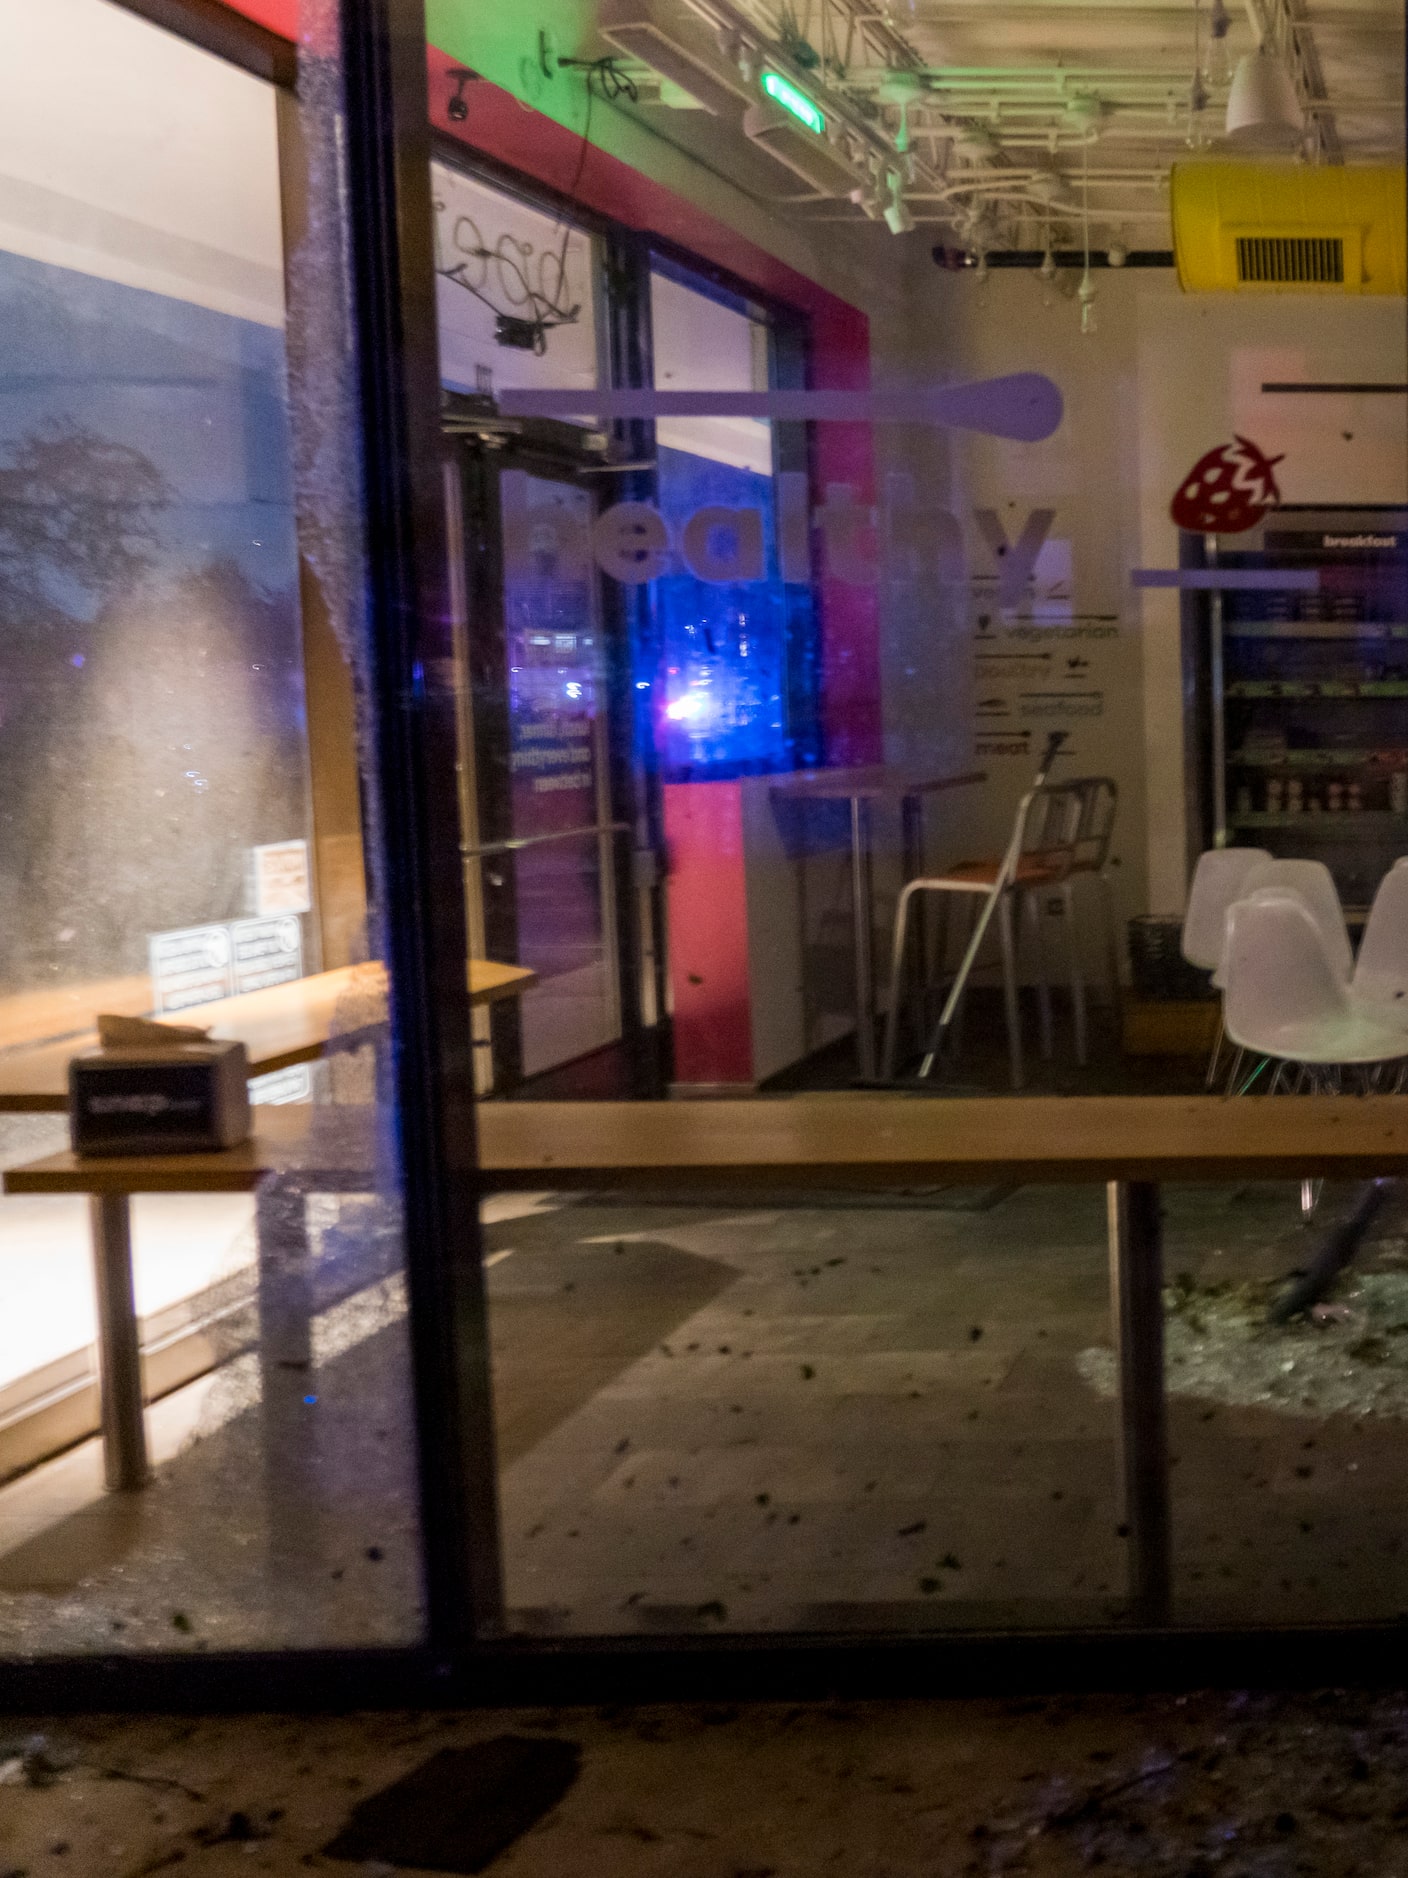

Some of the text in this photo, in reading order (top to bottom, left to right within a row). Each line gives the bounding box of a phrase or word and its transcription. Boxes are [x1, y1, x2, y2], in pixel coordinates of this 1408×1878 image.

[1322, 534, 1397, 548] breakfast
[1006, 624, 1119, 643] vegetarian
[1019, 701, 1104, 716] seafood
[974, 740, 1029, 755] meat
